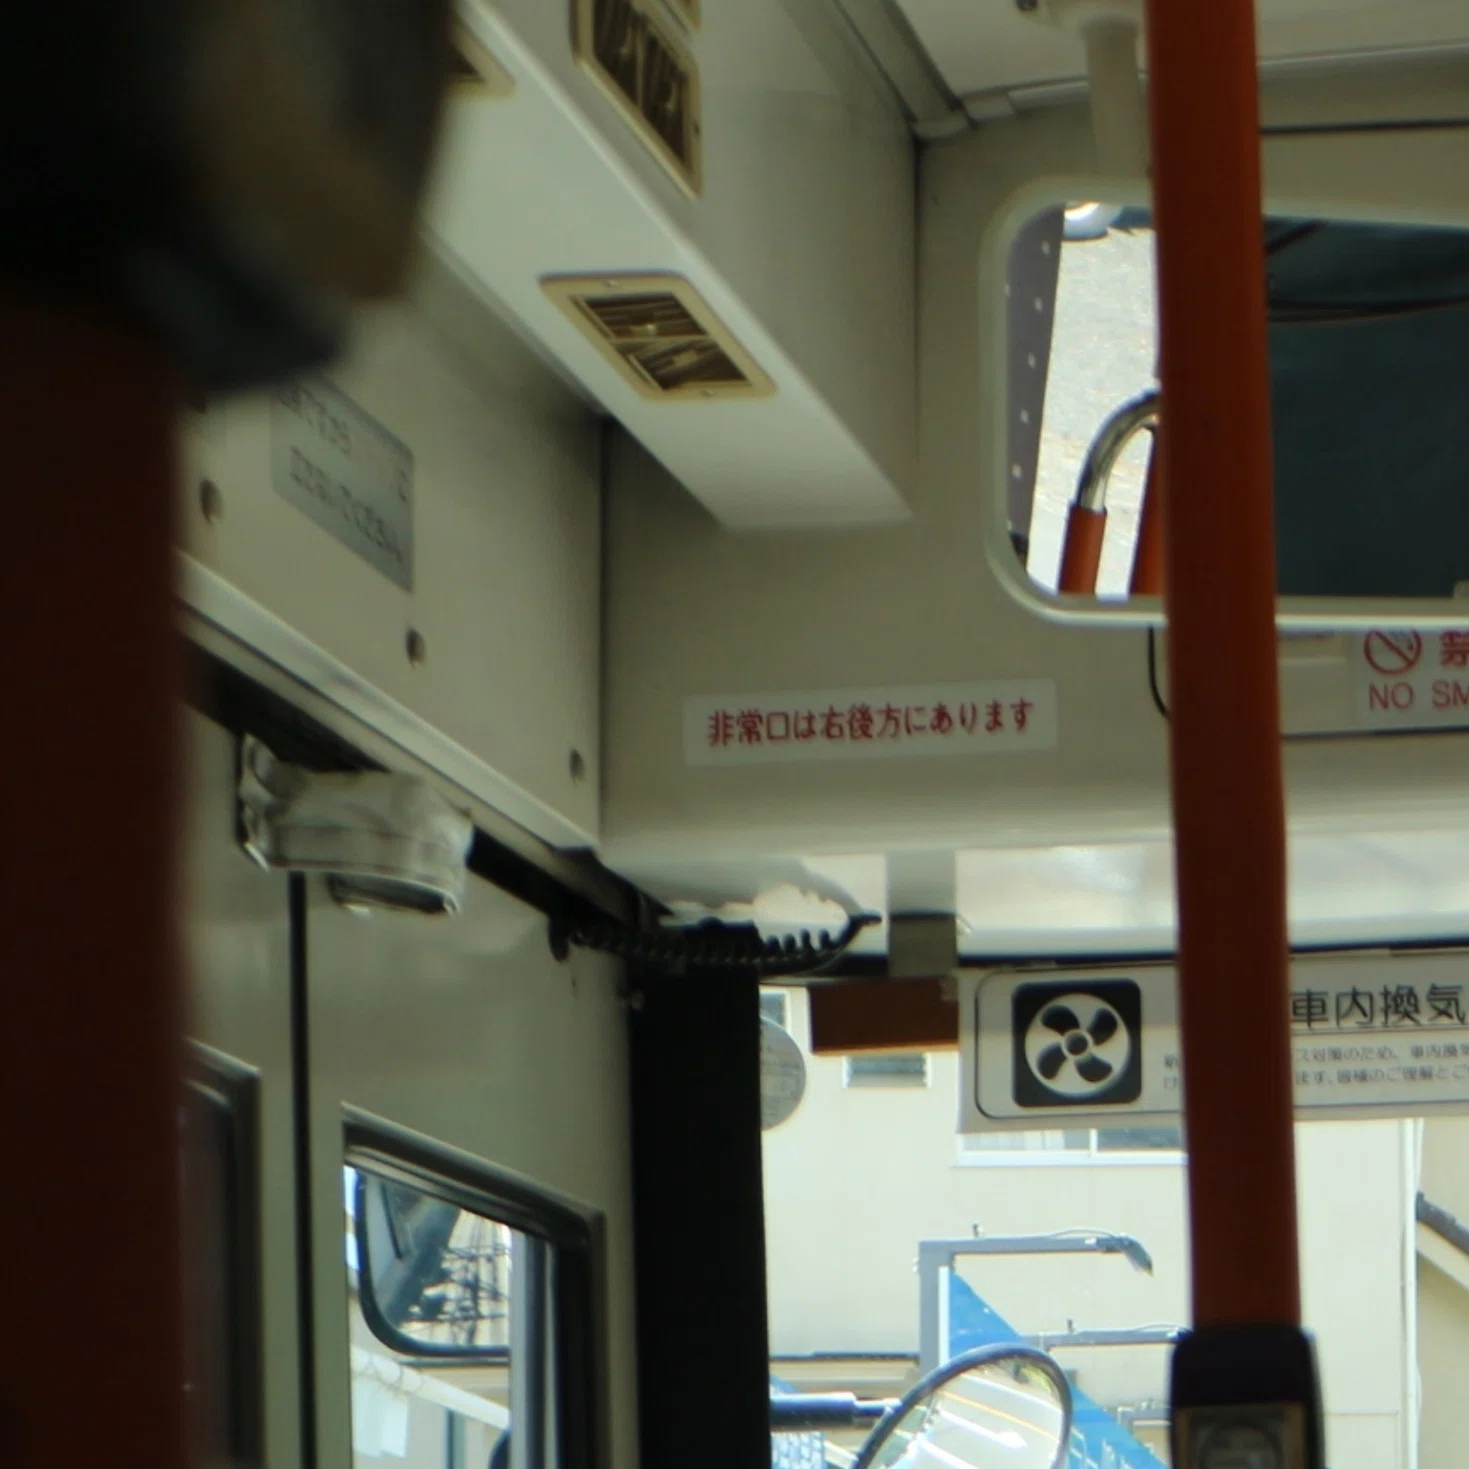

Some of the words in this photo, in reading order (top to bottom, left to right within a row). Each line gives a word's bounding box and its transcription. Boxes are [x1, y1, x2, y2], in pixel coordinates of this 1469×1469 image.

[1368, 682, 1415, 711] NO
[708, 695, 1033, 746] 非常口は右後方にあります
